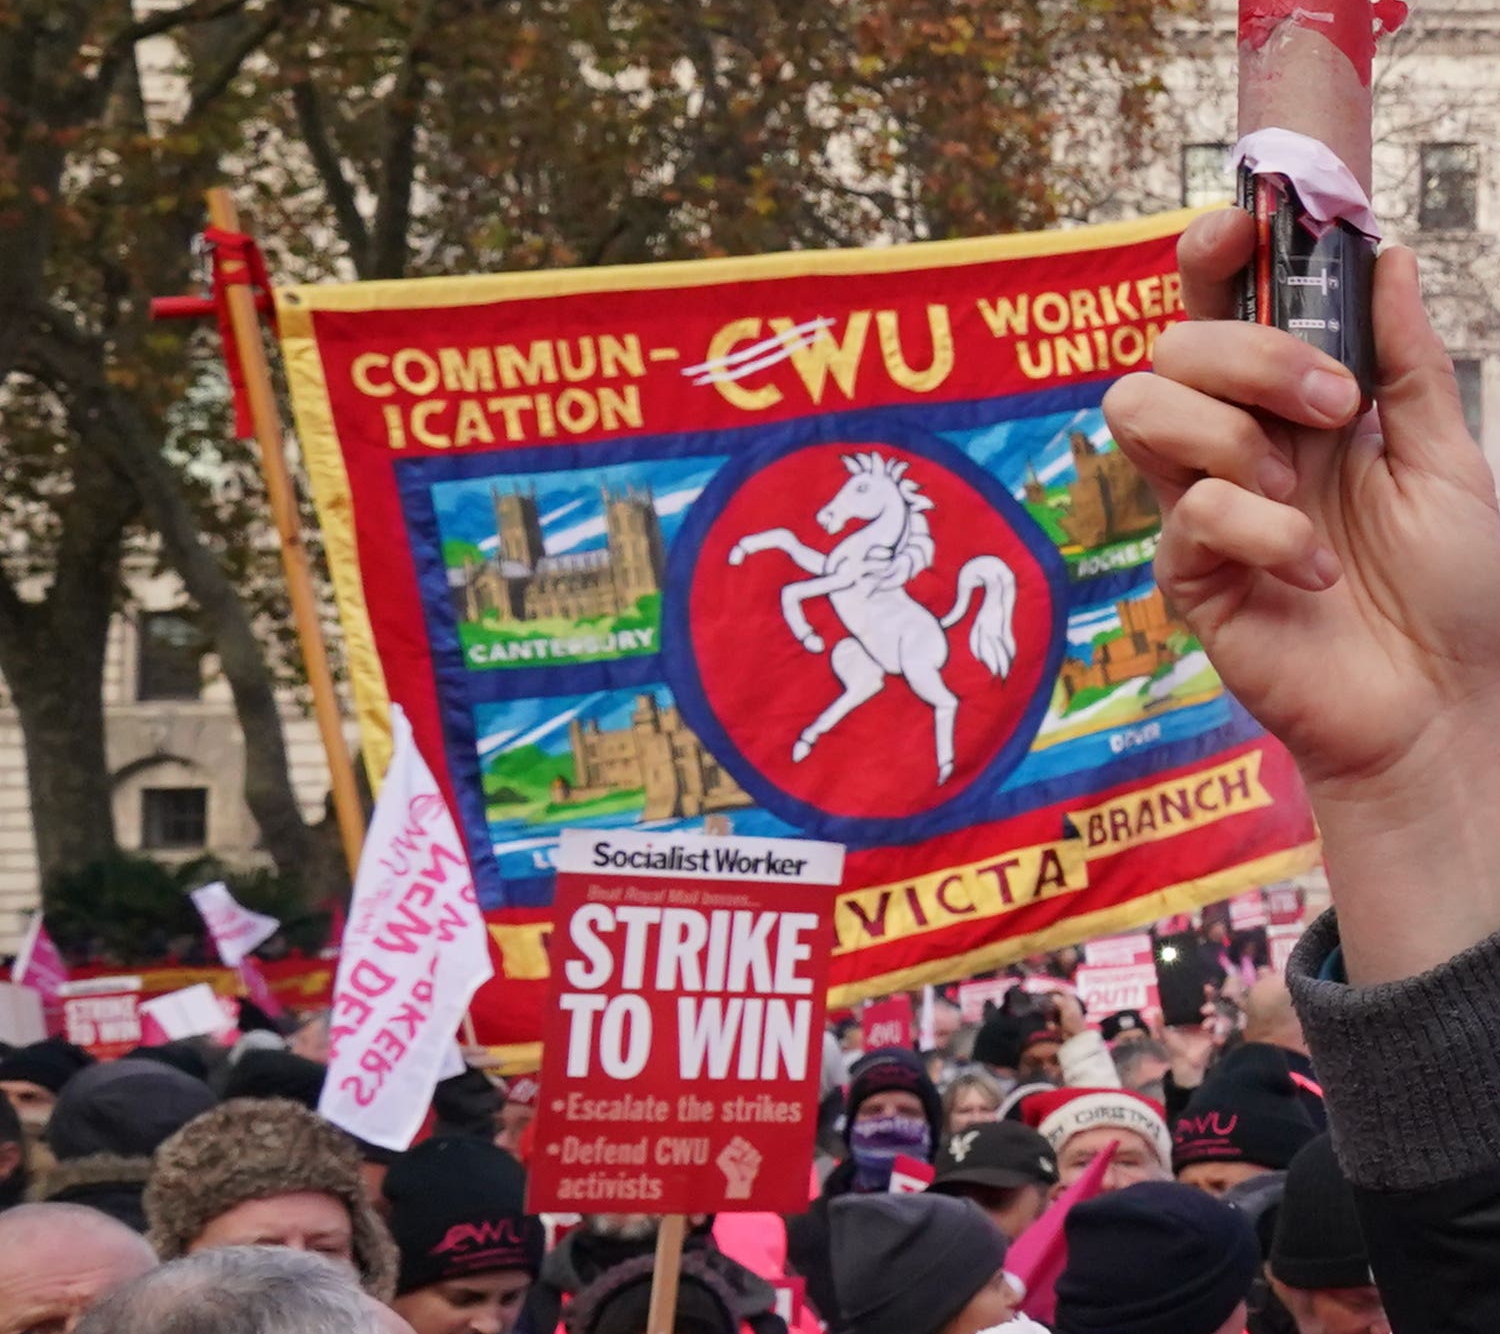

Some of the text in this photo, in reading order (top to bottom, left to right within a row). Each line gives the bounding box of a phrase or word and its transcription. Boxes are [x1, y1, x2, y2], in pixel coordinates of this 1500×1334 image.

[351, 333, 680, 398] COMMUN-
[682, 304, 954, 411] CWU
[382, 384, 645, 450] ICATION
[1087, 766, 1251, 848] BRANCH
[592, 842, 711, 873] Socialist
[714, 849, 808, 878] Worker
[624, 886, 665, 907] Royal
[668, 888, 698, 907] Mail
[564, 902, 820, 995] STRIKE
[1084, 982, 1144, 1011] OUT!
[558, 992, 813, 1082] TO WIN
[677, 1094, 715, 1122] the
[721, 1095, 804, 1123] strikes
[654, 1136, 711, 1167] CWU
[556, 1172, 664, 1201] activists
